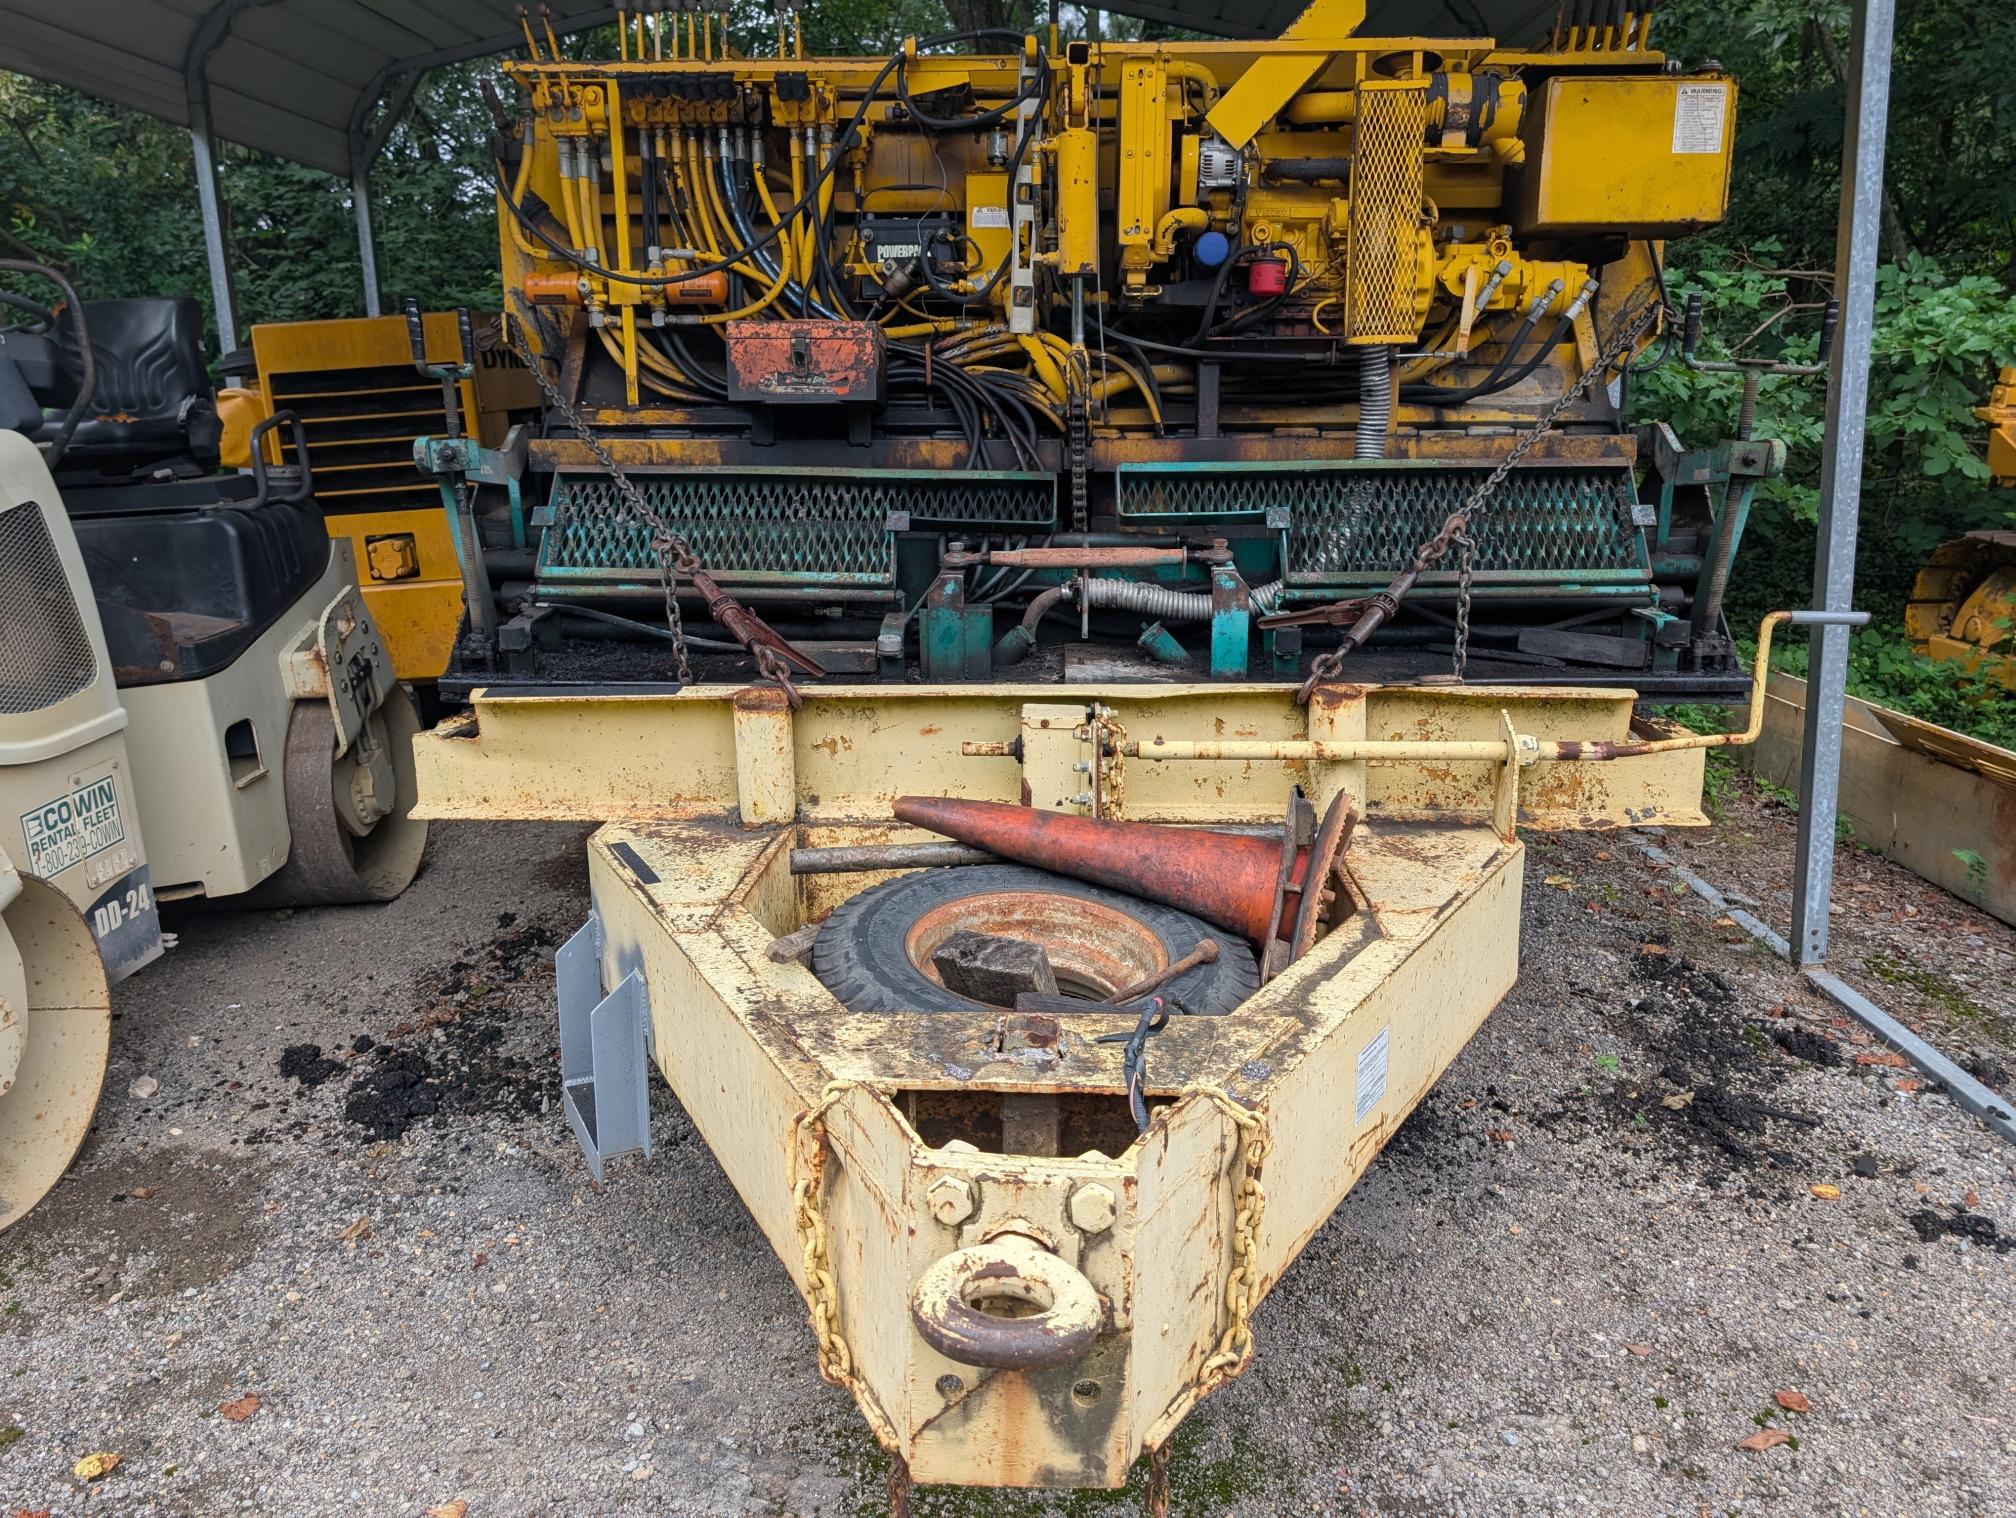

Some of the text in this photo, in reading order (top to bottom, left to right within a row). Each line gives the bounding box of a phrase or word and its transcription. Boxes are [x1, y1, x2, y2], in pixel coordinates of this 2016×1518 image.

[30, 804, 116, 856] RENTAL FLEET
[43, 781, 114, 831] COWIN
[94, 883, 150, 938] DD-24
